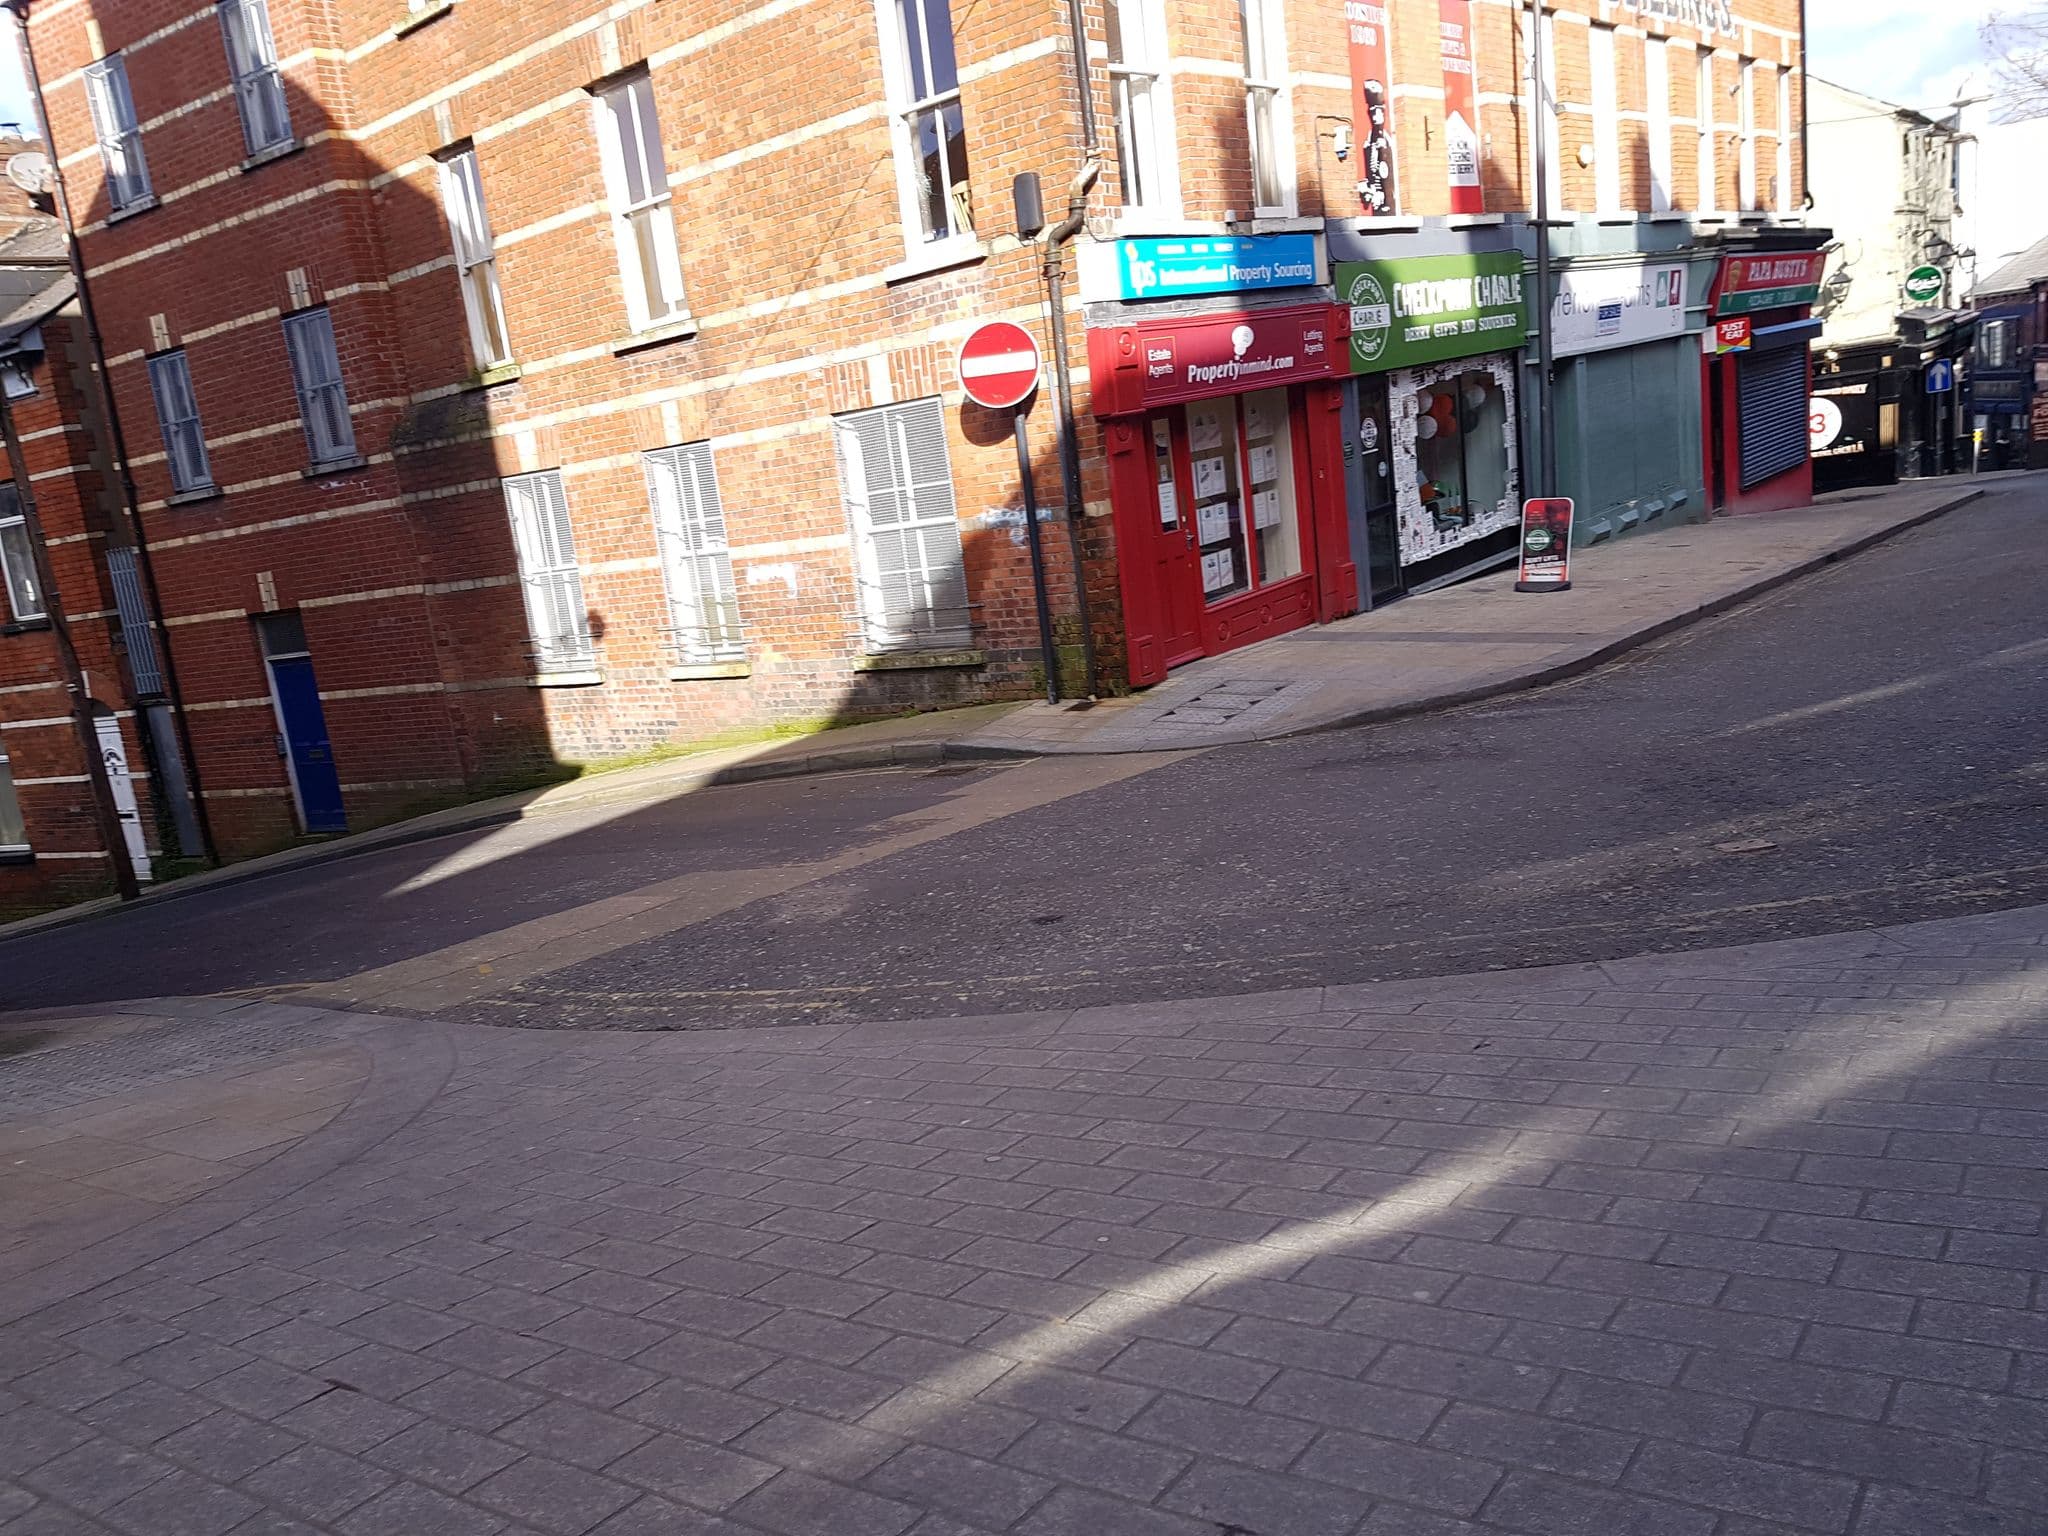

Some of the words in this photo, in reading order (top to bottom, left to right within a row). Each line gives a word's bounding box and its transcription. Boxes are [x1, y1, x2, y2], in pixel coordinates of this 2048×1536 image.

[1160, 264, 1228, 286] International
[1229, 264, 1272, 283] Property
[1274, 260, 1312, 280] Sourcing
[1393, 278, 1473, 317] CHECKPOINT
[1474, 274, 1522, 308] CHARLIE
[1720, 321, 1746, 334] JUST
[1725, 329, 1746, 340] EAT
[1147, 349, 1172, 361] Estate
[1304, 343, 1324, 356] Agents
[1148, 364, 1174, 378] Agents
[1187, 354, 1294, 384] Propertyinmind.com
